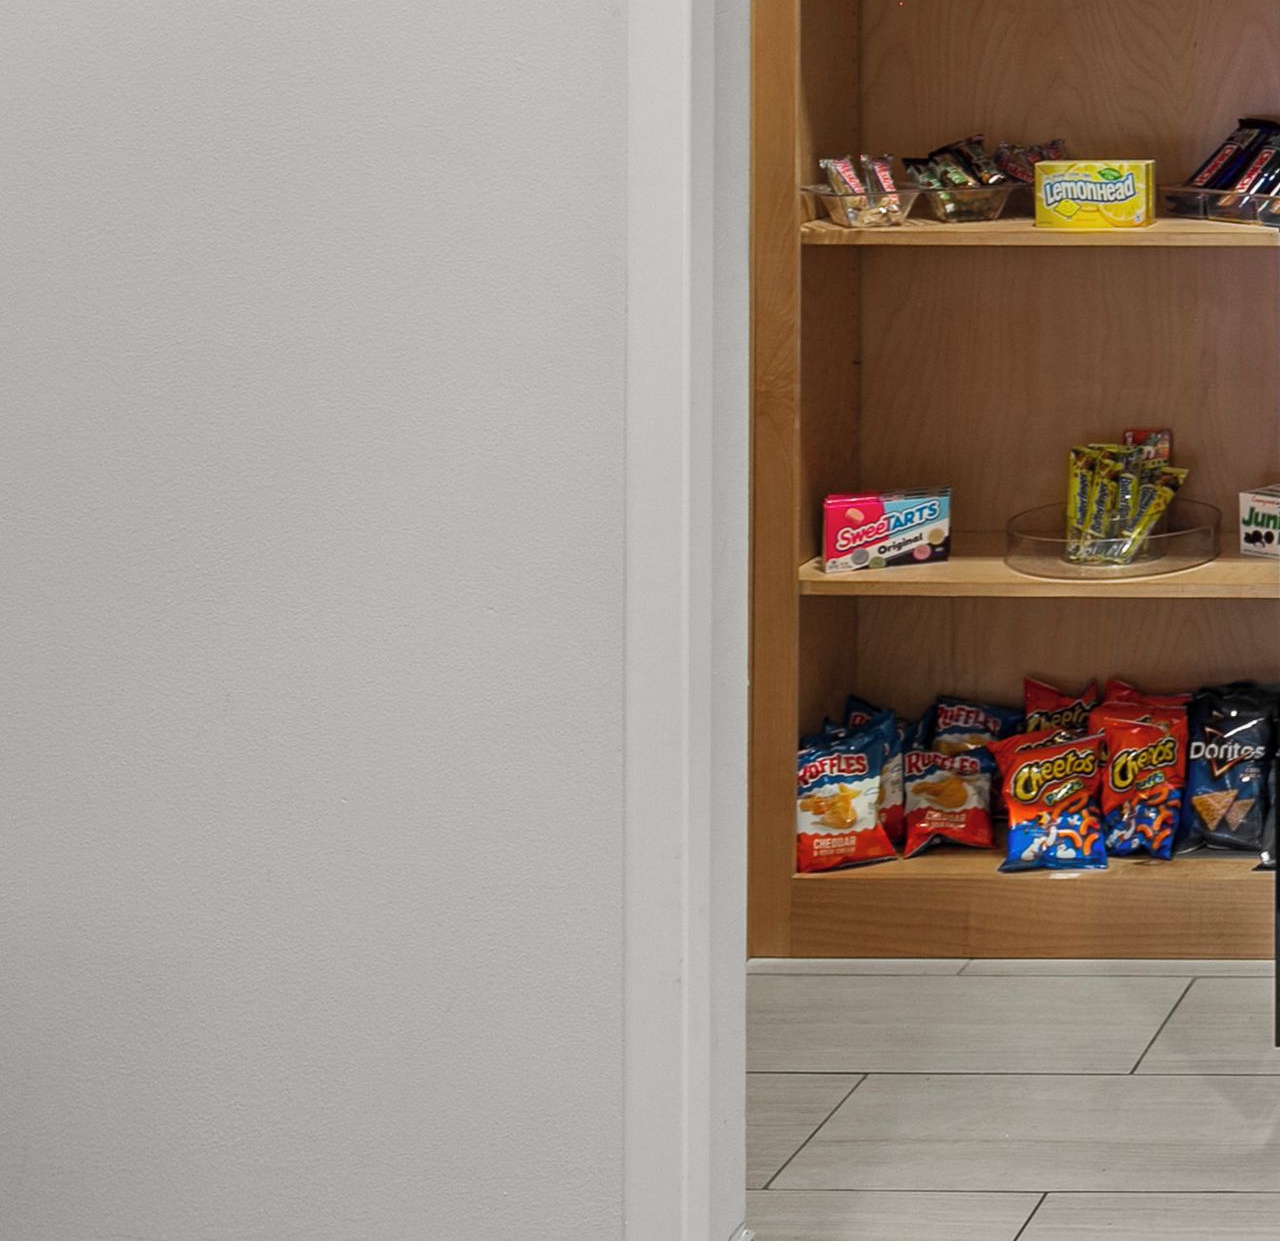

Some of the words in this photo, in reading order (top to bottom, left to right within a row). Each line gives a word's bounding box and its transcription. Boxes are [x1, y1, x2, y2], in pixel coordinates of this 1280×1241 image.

[877, 533, 924, 555] Original
[1109, 737, 1178, 793] Cheetos
[1189, 740, 1266, 761] Doritos
[1011, 749, 1098, 804] Cheetos
